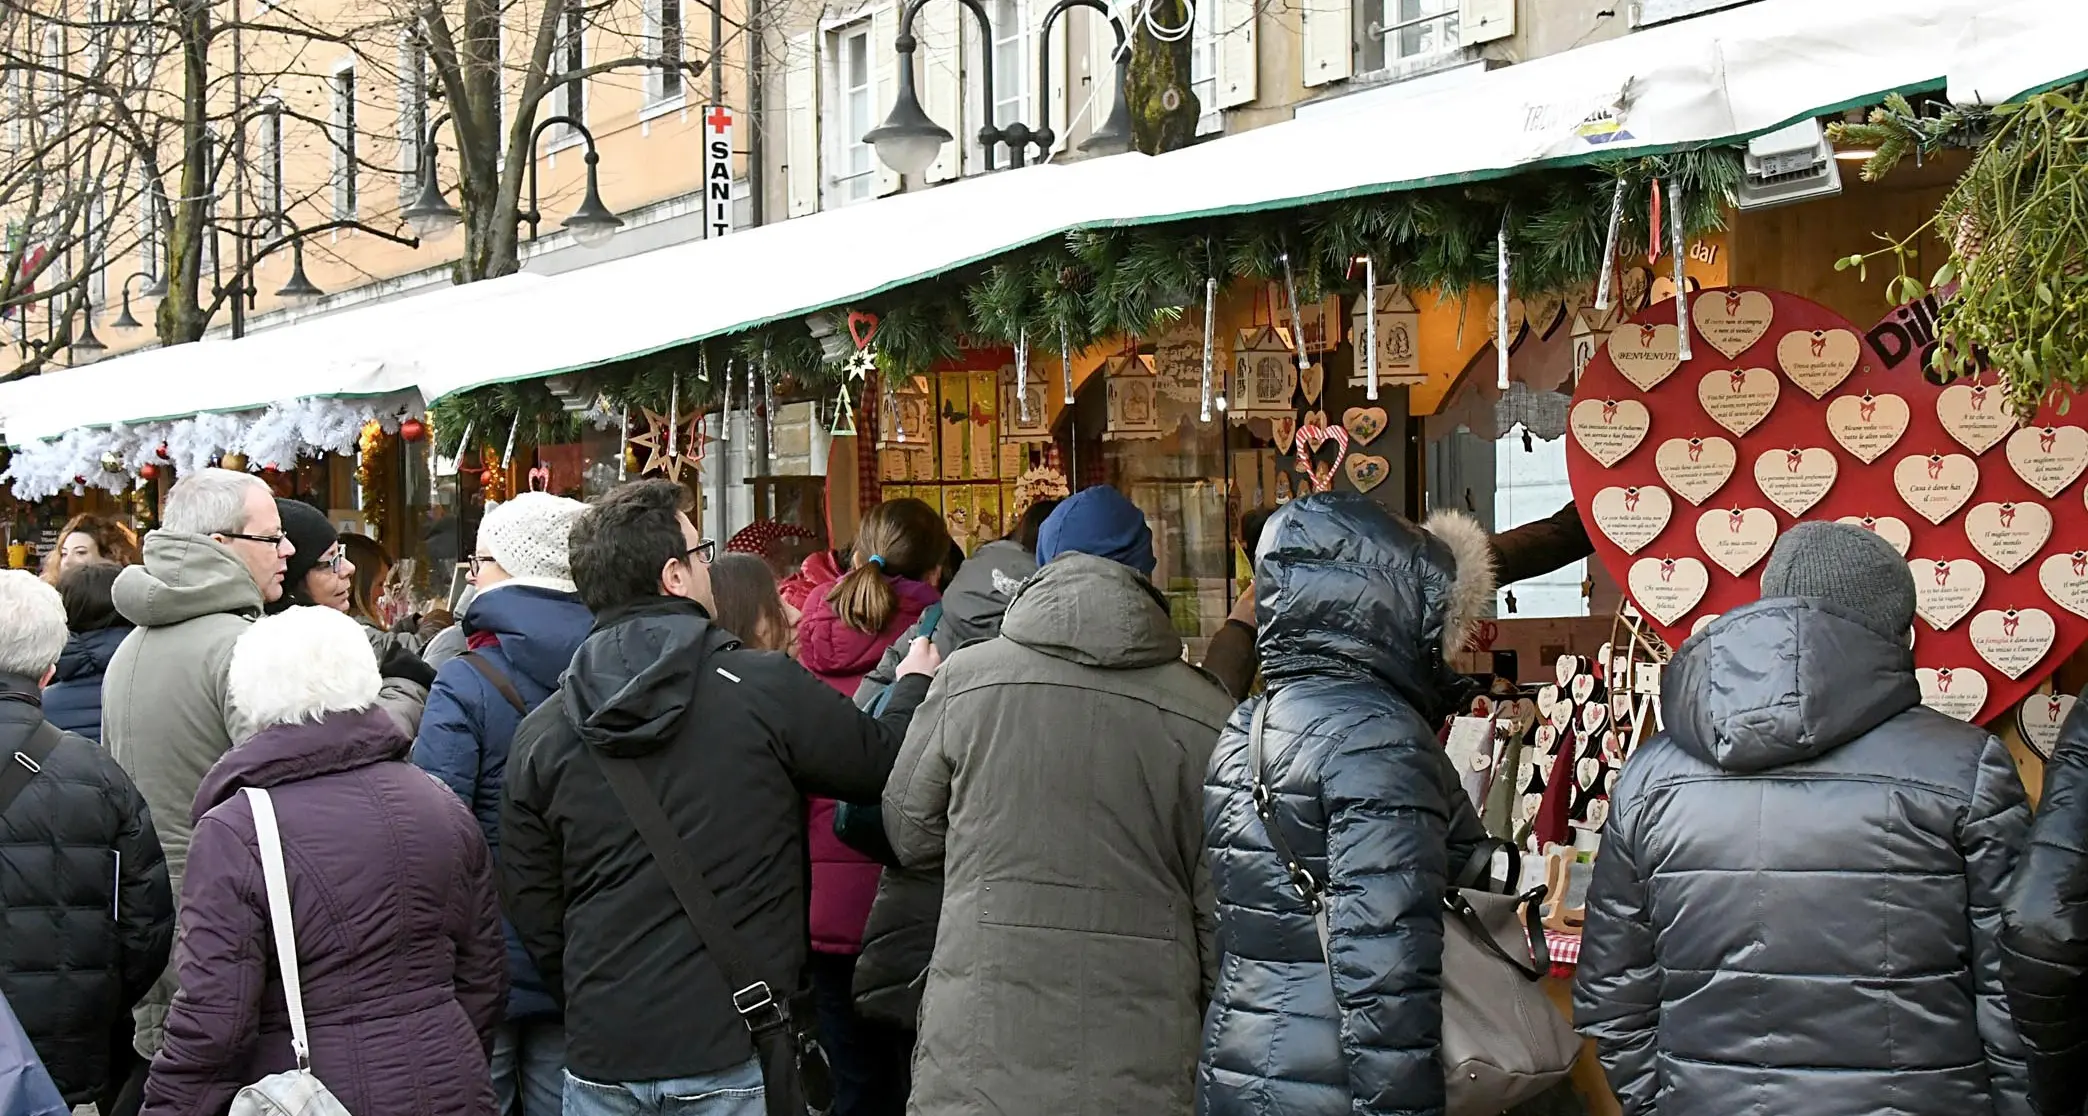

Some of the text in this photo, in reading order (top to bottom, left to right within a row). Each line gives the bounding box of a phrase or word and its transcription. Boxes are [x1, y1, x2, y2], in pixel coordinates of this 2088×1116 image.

[710, 141, 729, 237] SANIT
[1690, 240, 1719, 265] dal
[1618, 351, 1677, 360] BENVENUTI
[1910, 484, 1926, 492] Casa
[1932, 483, 1949, 491] dove
[1950, 483, 1961, 491] hai
